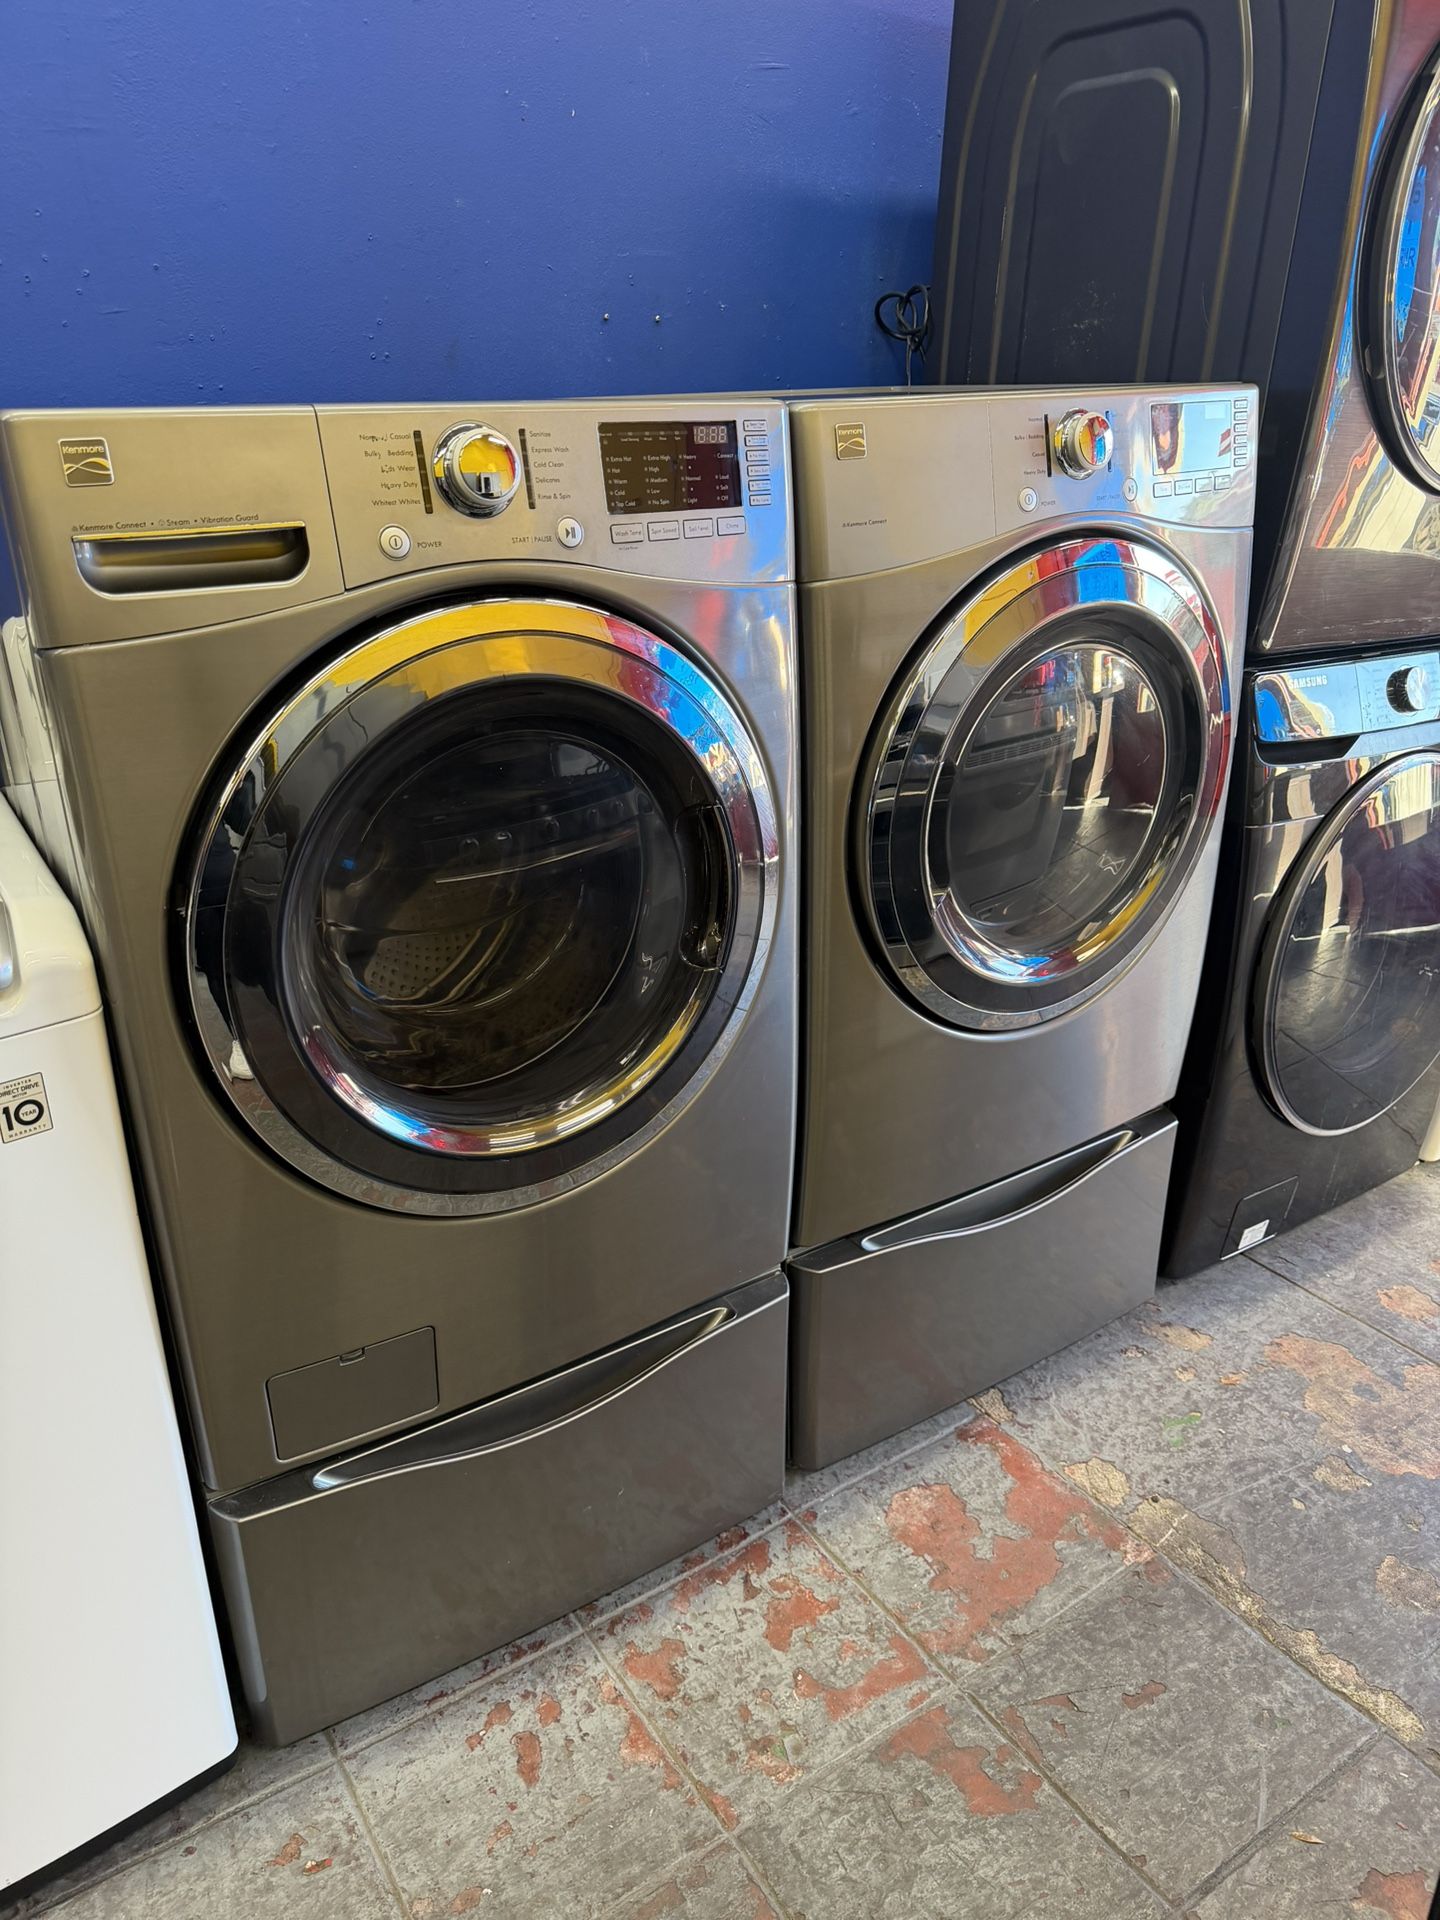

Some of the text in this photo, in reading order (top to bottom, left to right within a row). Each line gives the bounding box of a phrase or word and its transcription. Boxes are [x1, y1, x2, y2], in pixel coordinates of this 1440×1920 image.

[62, 446, 105, 455] Kenmore
[387, 449, 414, 457] Bedding
[166, 518, 191, 526] Steam
[200, 514, 259, 524] Vibration Guard
[79, 521, 147, 532] Kenmore Connect
[534, 535, 553, 543] PAUSE
[416, 541, 442, 549] POWER
[1289, 675, 1328, 689] SAMSUNG
[20, 1081, 40, 1092] DRIVE
[2, 1099, 45, 1132] 10
[21, 1109, 37, 1117] YEAR
